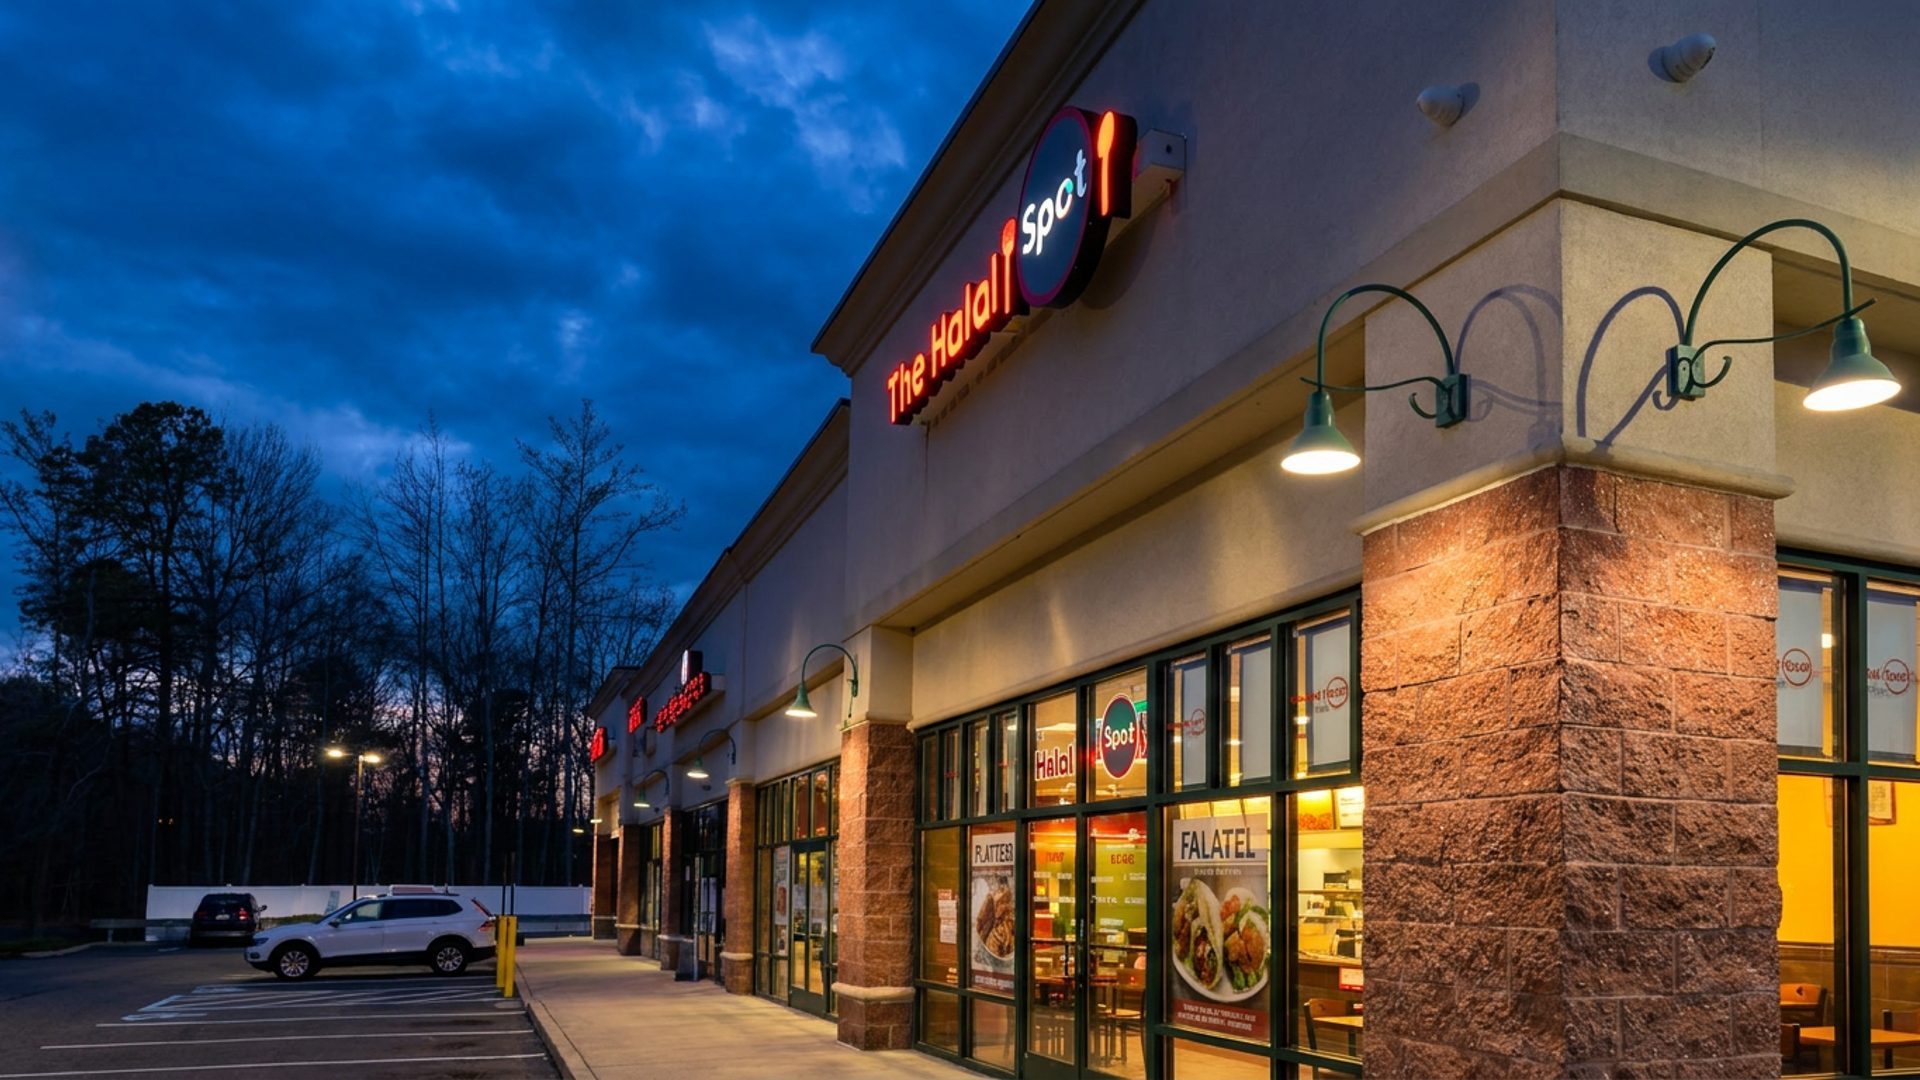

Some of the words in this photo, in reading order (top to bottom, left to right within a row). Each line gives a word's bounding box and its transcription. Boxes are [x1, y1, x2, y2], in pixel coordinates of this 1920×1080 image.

[887, 352, 926, 424] The
[930, 252, 998, 378] Halal
[1021, 148, 1087, 256] Spot
[1104, 722, 1136, 750] Spot
[1180, 827, 1256, 860] FALATEL
